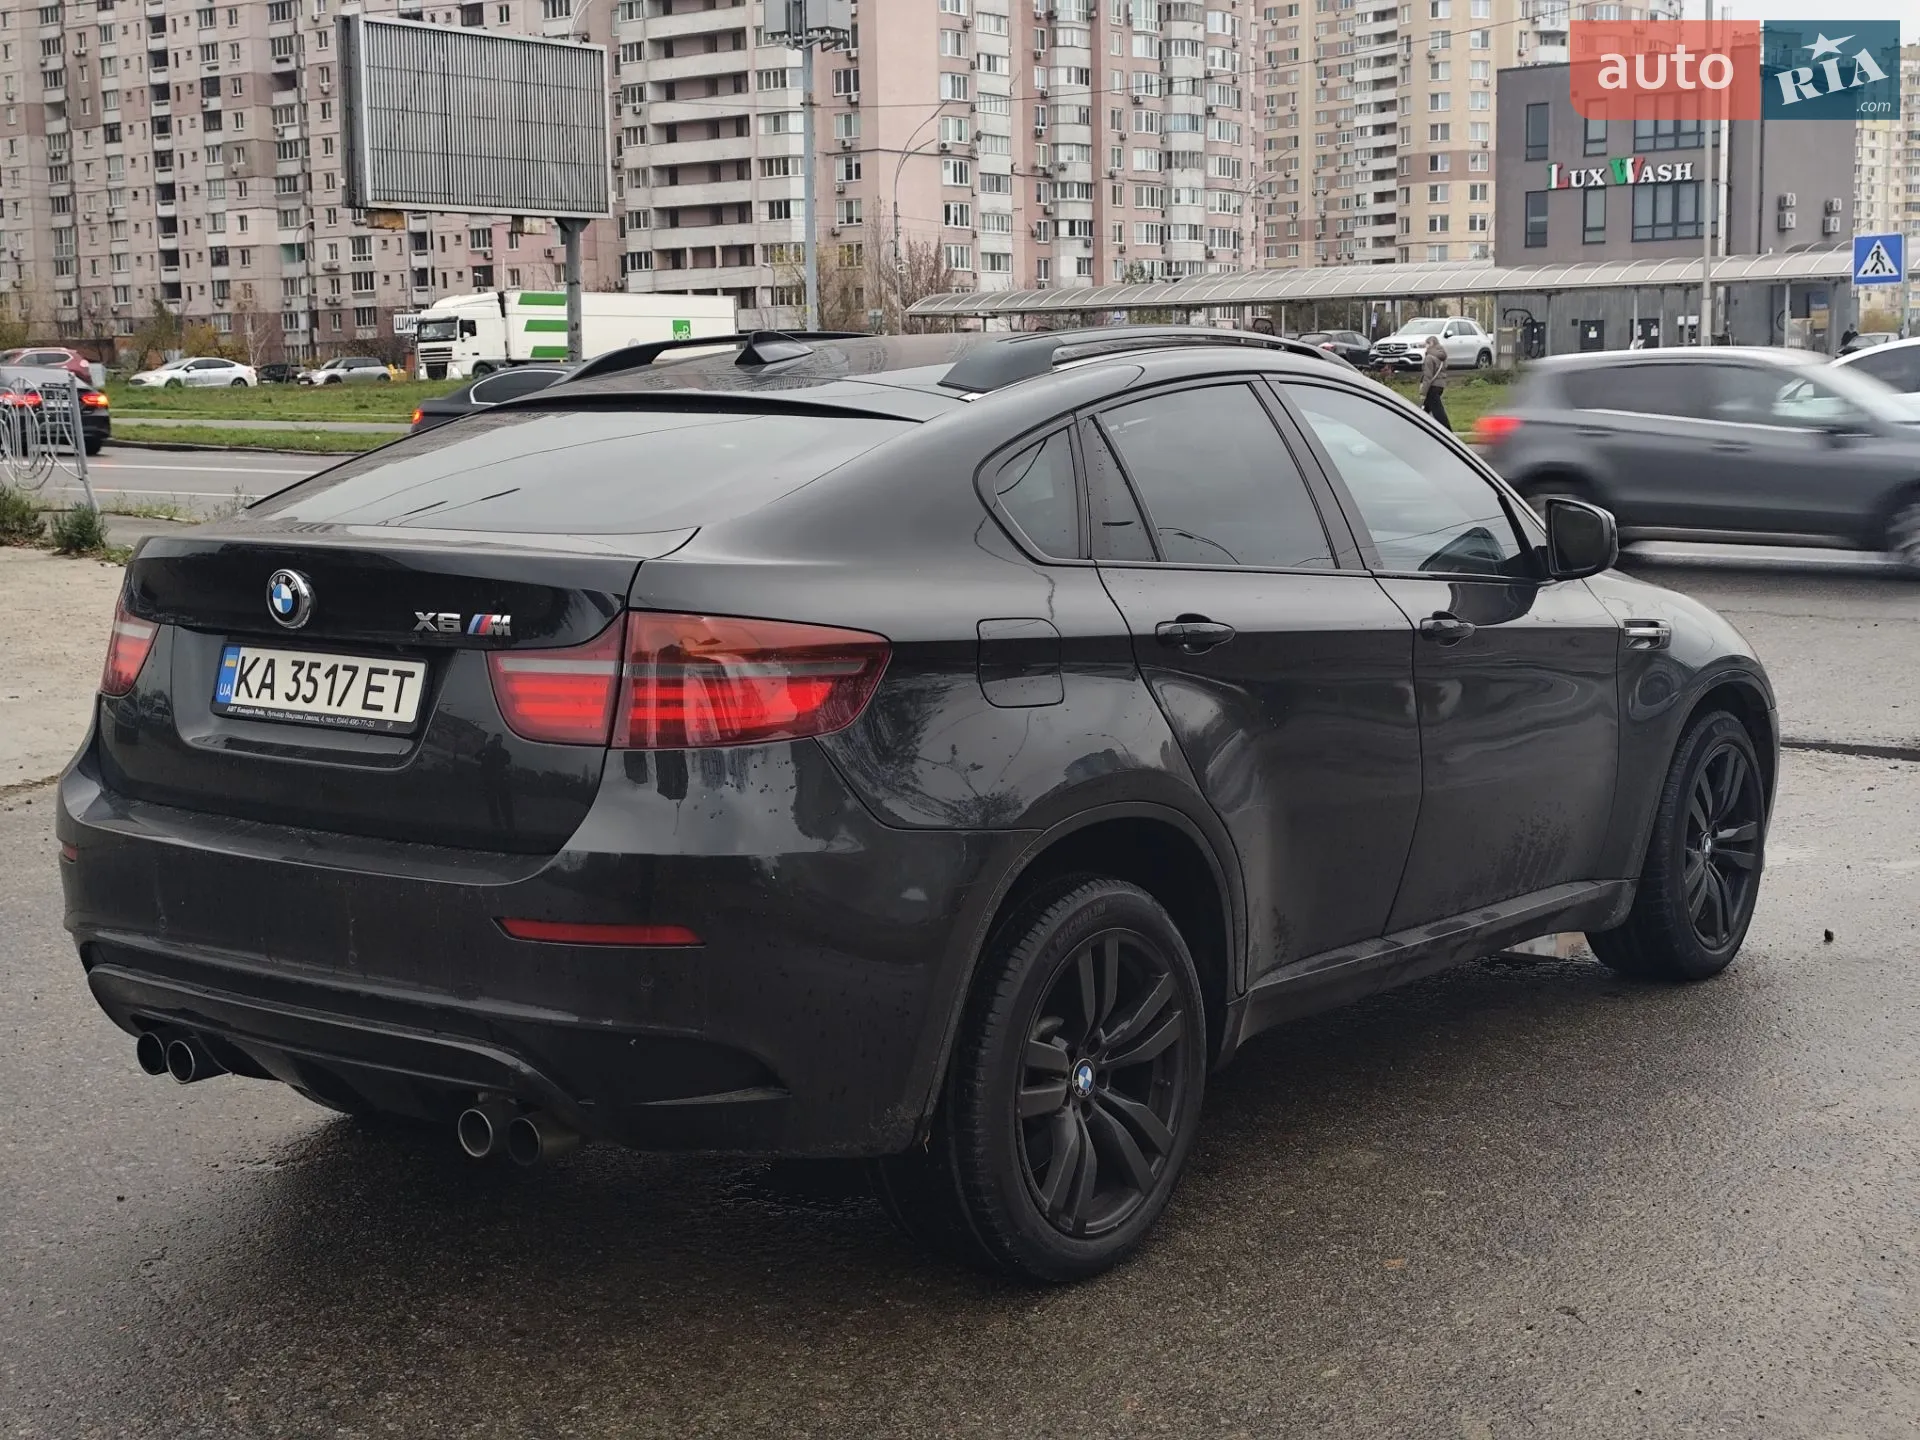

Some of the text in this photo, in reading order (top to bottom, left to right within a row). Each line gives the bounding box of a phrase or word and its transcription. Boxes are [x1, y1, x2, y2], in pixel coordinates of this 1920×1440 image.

[395, 316, 419, 331] ШИН
[270, 575, 298, 592] BMW
[413, 611, 462, 633] X6
[219, 684, 231, 698] UA
[234, 655, 416, 714] KA 3517 ET
